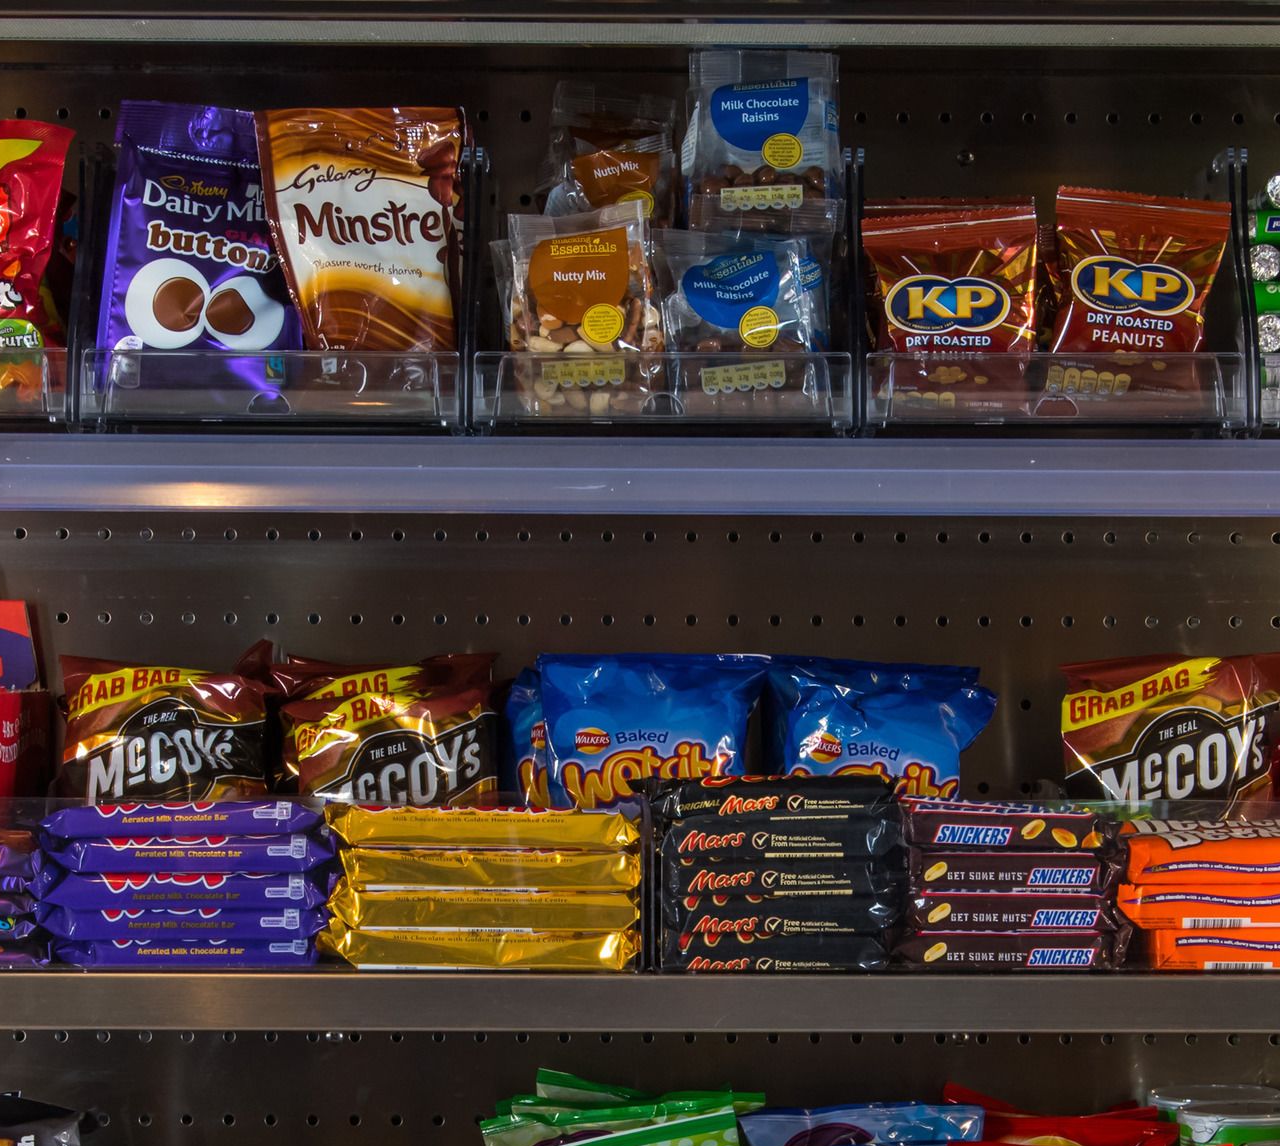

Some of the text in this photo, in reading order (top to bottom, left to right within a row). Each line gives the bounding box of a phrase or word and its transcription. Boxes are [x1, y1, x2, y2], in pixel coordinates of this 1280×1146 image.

[722, 98, 799, 111] Milk Chocolate
[742, 113, 779, 123] Raisins
[292, 164, 376, 192] Galaxy
[594, 161, 639, 180] Nutty Mix
[550, 242, 617, 256] Essentials
[354, 260, 384, 274] worth
[388, 264, 423, 278] sharing
[553, 270, 606, 282] Nutty Mix
[1093, 266, 1183, 302] KP
[906, 286, 996, 319] KP
[1087, 312, 1173, 332] DRY ROASTED
[906, 334, 991, 348] DRY ROASTED
[1092, 328, 1164, 348] PEANUTS
[132, 669, 181, 691] BAG
[1070, 669, 1189, 723] GRAB BAG
[143, 711, 178, 725] THE REAL
[615, 730, 669, 744] Baked
[847, 741, 900, 761] Baked
[719, 794, 779, 816] Mars
[122, 815, 154, 823] Aerated
[678, 830, 746, 854] Mars
[935, 825, 1011, 845] SNICKERS
[946, 871, 1022, 881] GET SOME NUTS
[1028, 868, 1094, 885] SNICKERS
